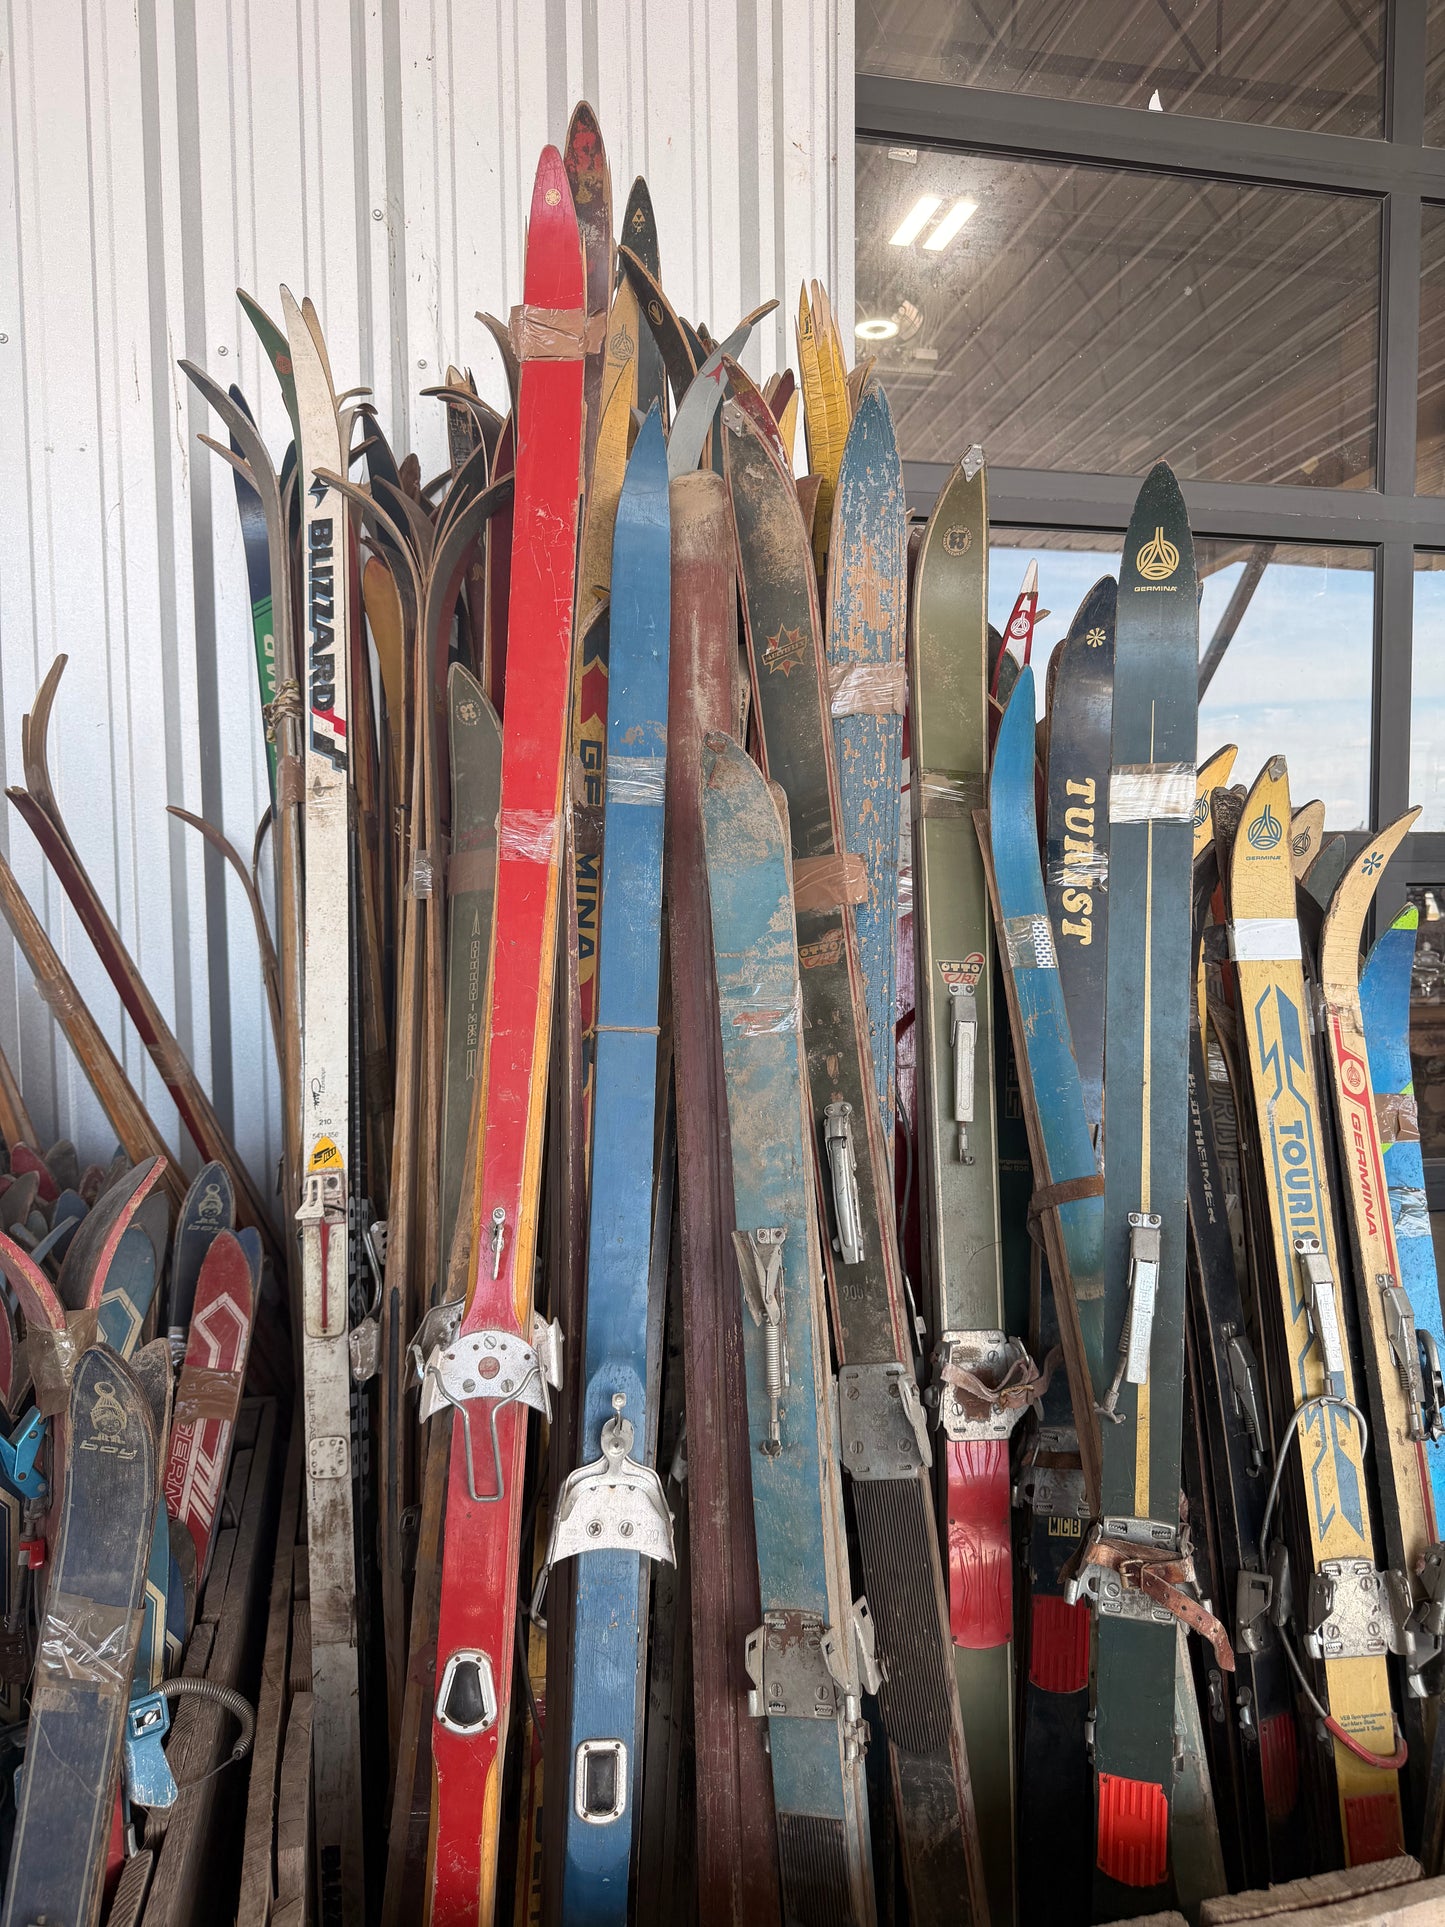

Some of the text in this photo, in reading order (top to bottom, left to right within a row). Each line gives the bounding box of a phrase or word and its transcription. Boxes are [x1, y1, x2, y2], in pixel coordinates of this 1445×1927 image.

[309, 518, 335, 711] BLIZZARD
[575, 739, 602, 960] GEMINA
[1061, 777, 1096, 946] TURIST
[941, 961, 980, 973] OTTO
[1351, 1112, 1378, 1236] GERMINA
[80, 1440, 138, 1460] boy
[164, 1421, 196, 1521] GERM
[1049, 1517, 1079, 1535] MCB
